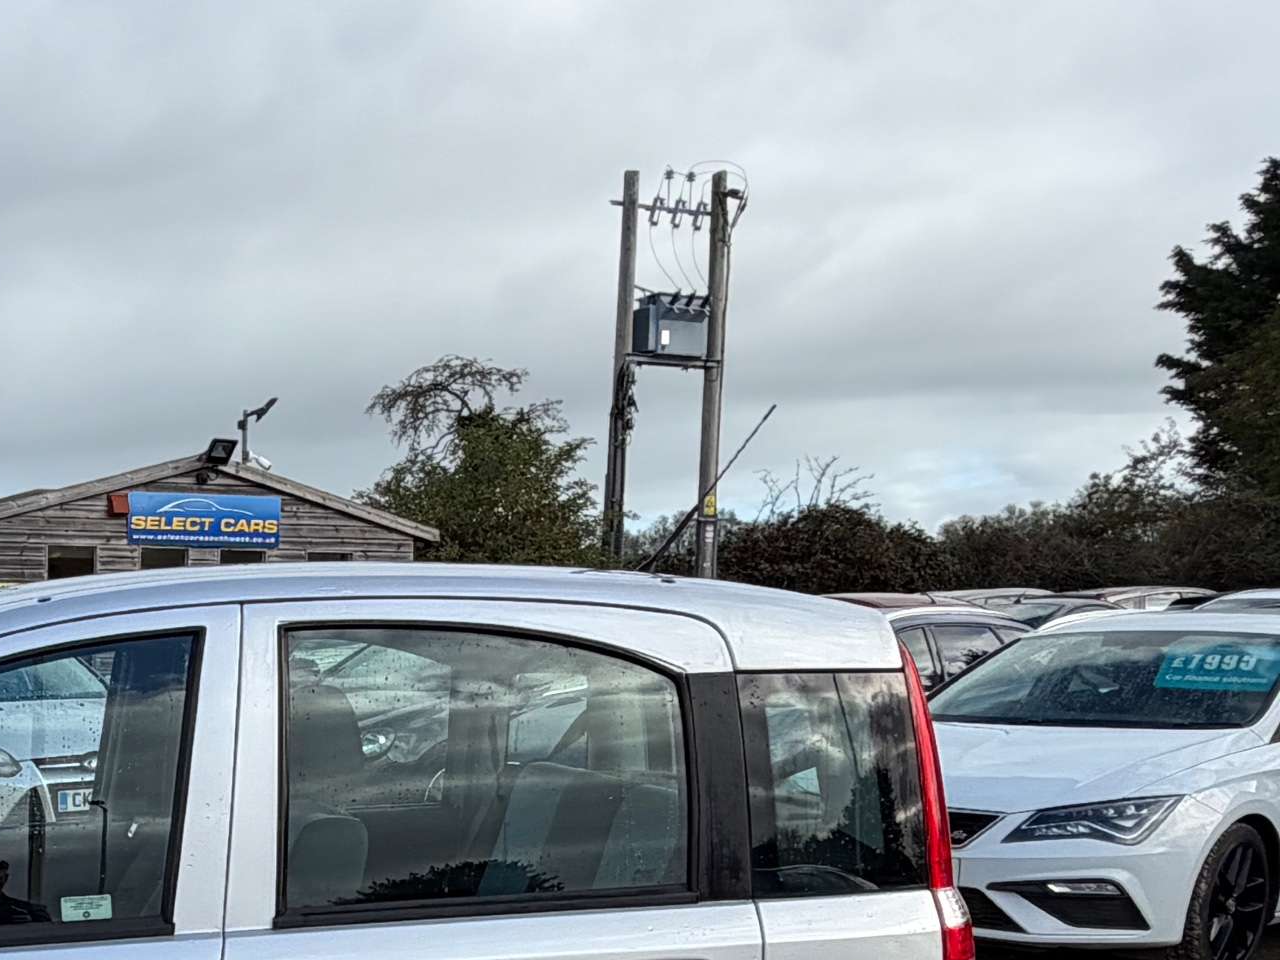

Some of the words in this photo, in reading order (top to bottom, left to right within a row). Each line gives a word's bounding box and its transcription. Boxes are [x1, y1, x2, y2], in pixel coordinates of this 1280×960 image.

[131, 516, 214, 532] SELECT
[220, 518, 278, 534] CARS
[1170, 653, 1258, 672] £7995
